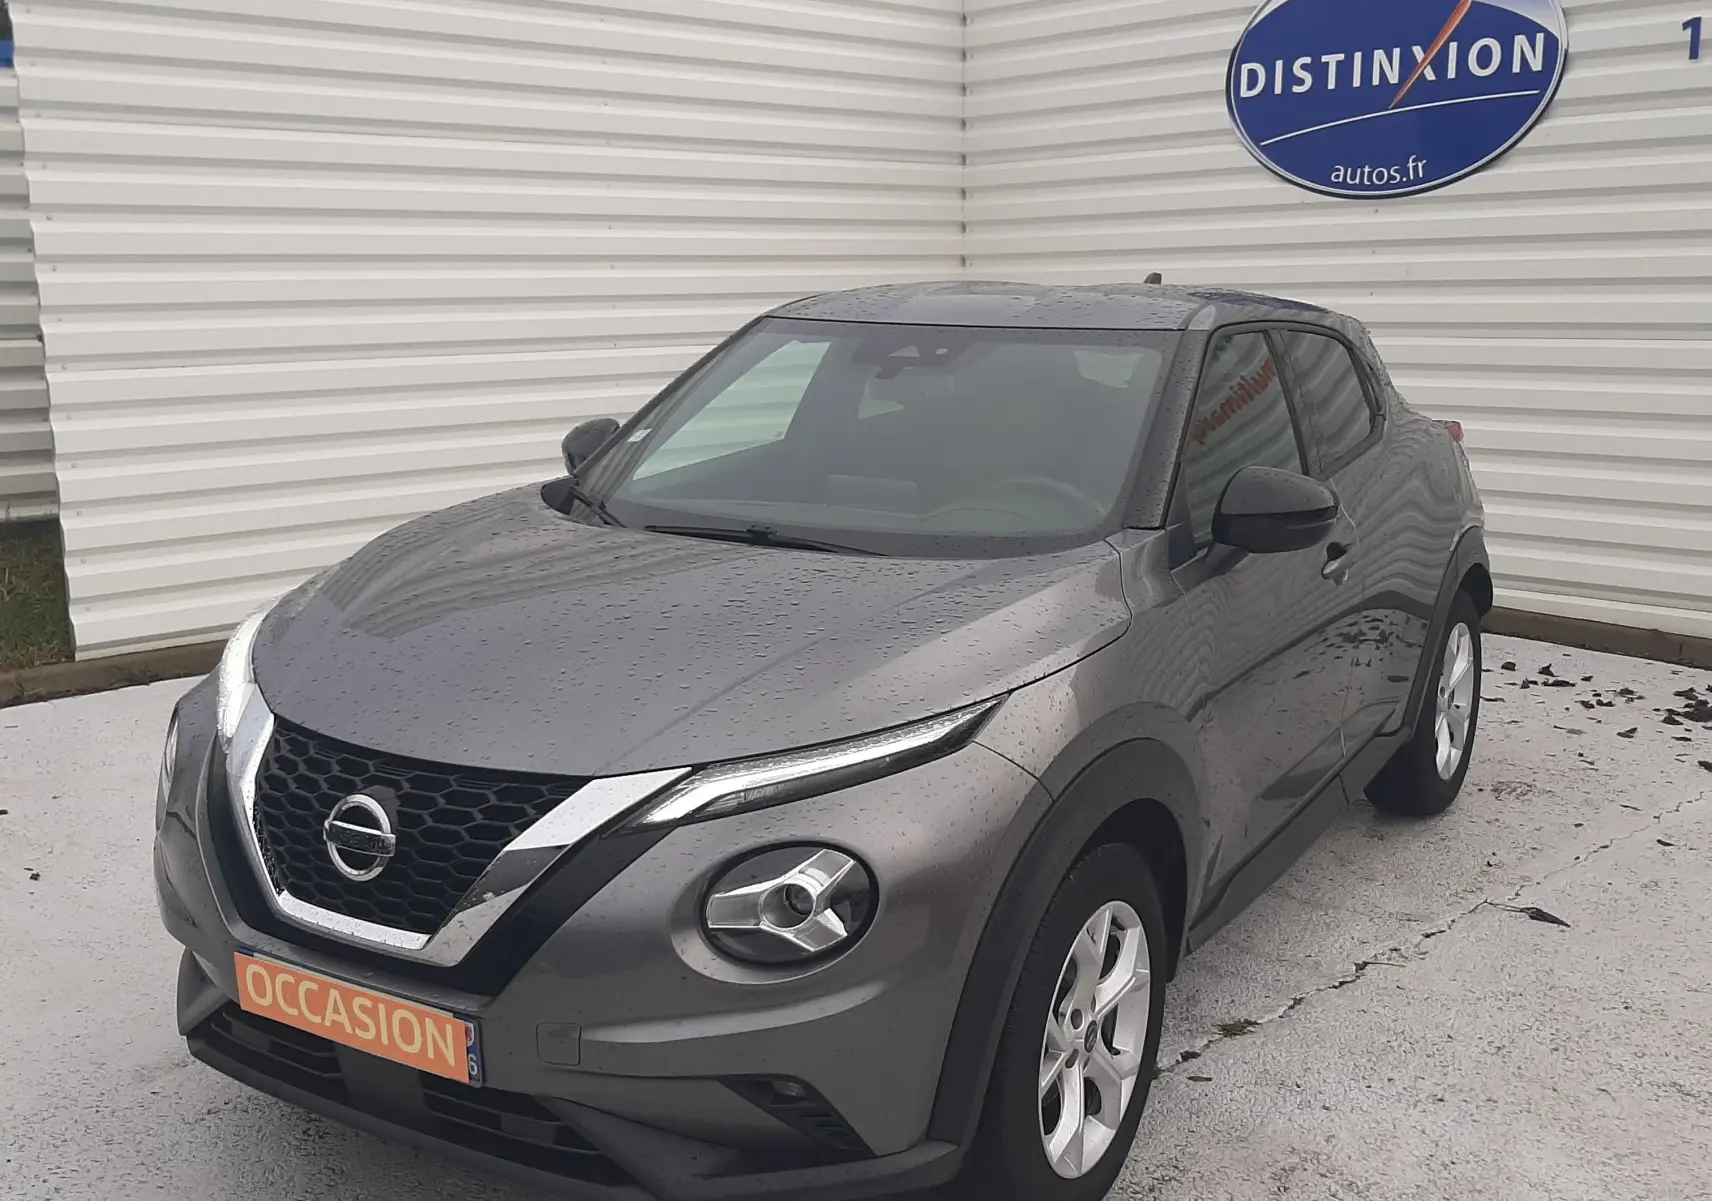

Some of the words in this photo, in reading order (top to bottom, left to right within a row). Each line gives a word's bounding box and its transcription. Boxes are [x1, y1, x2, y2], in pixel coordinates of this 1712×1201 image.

[1240, 32, 1545, 98] DISTINXION
[1330, 154, 1428, 186] autos.fr
[245, 964, 455, 1067] OCCASION
